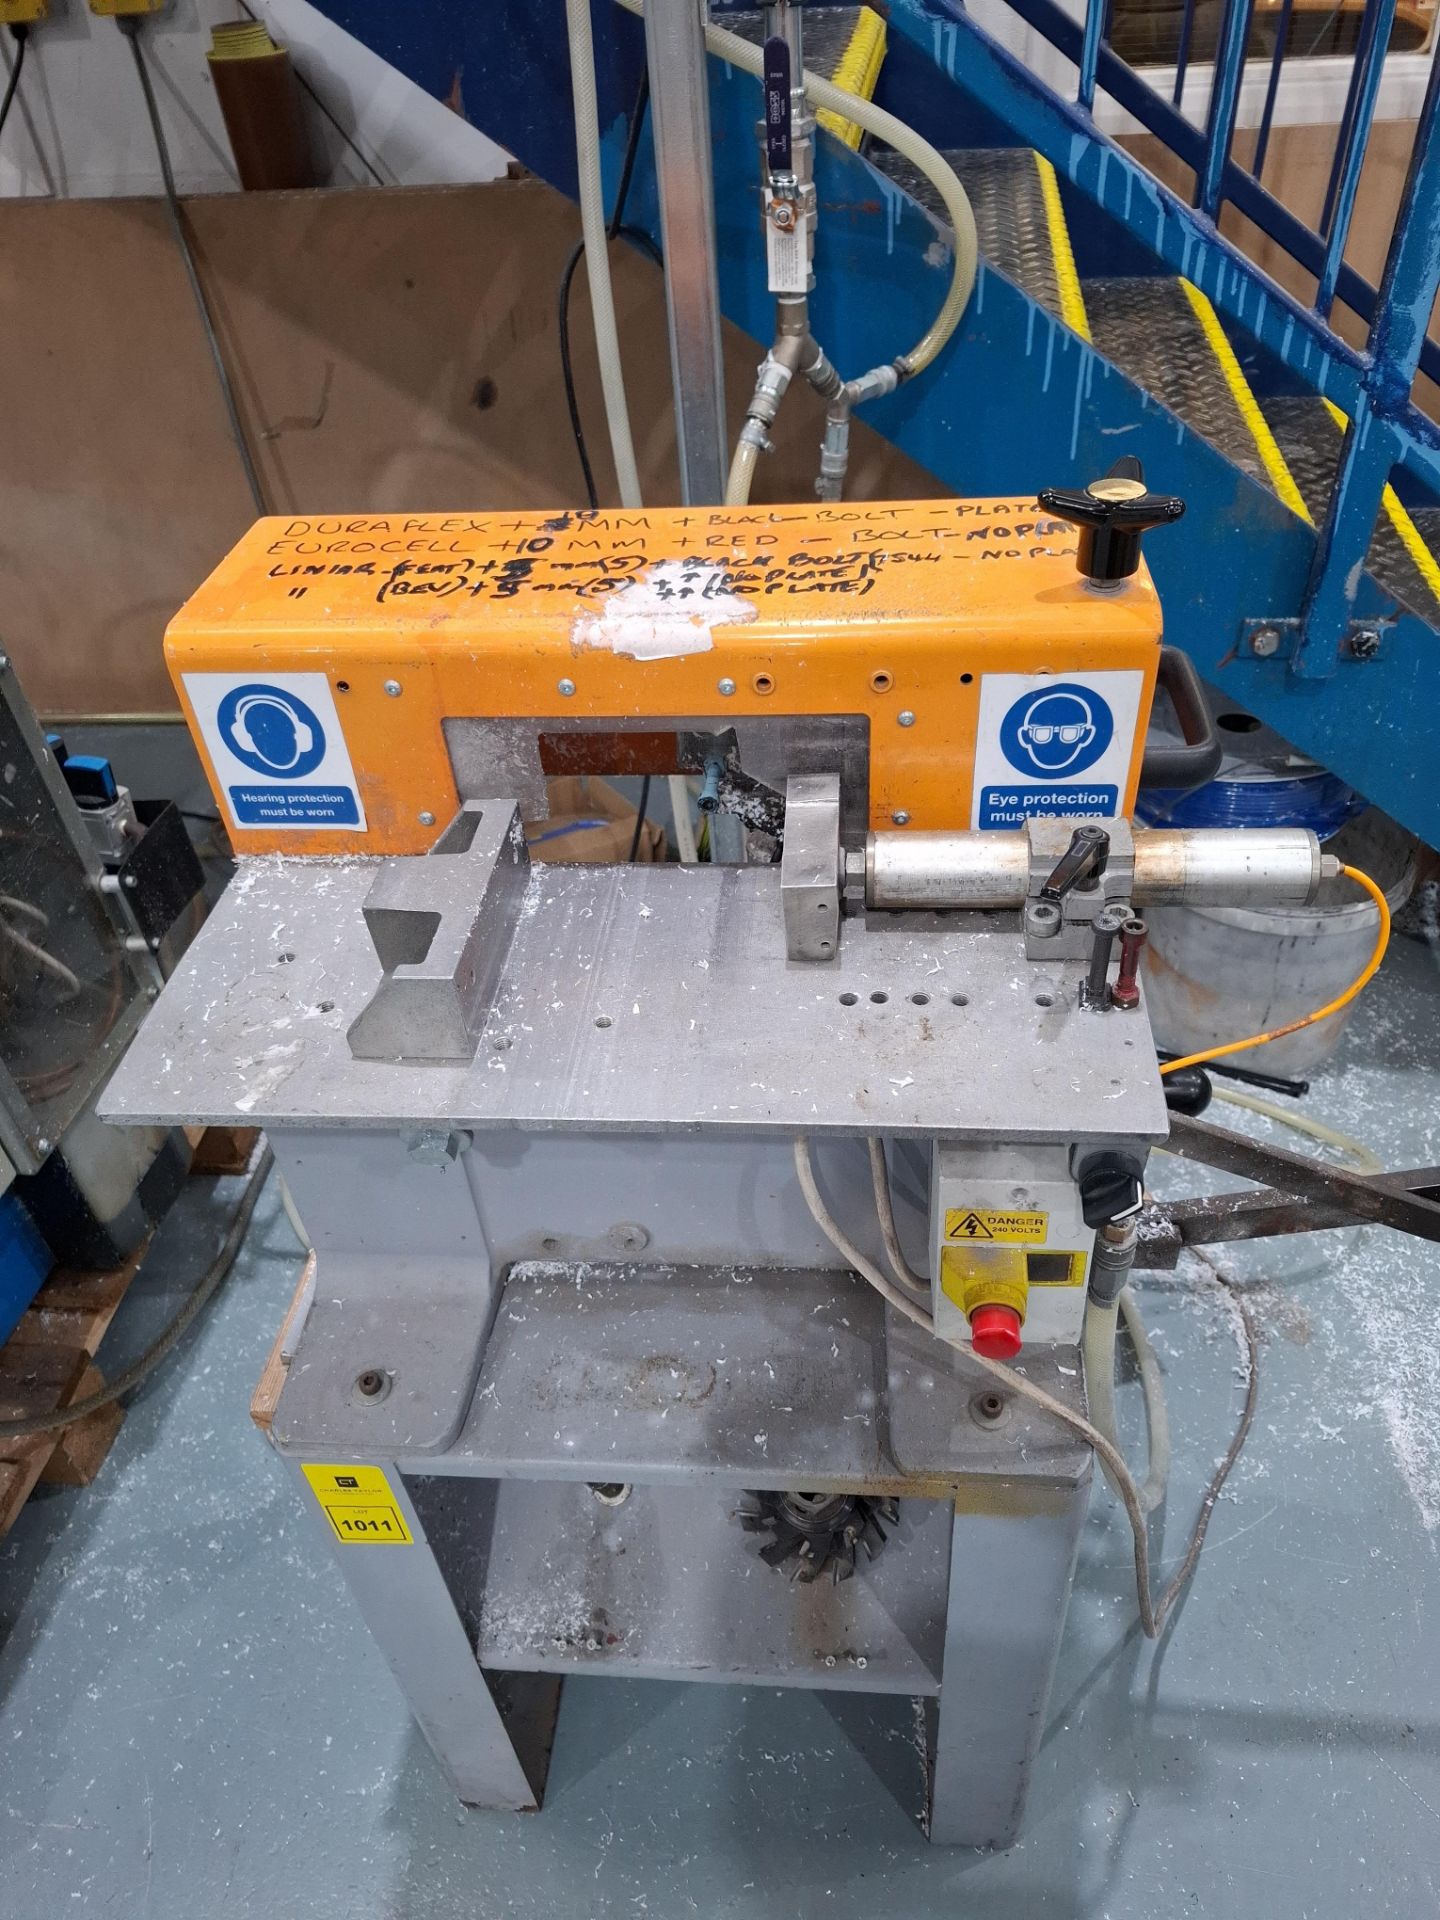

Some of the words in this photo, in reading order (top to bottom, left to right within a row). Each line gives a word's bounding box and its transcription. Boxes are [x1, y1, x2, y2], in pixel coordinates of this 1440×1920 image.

[816, 508, 914, 523] BOLT
[267, 540, 476, 555] EUROCELL
[706, 535, 779, 547] RED
[853, 528, 952, 542] BOLT
[241, 793, 285, 804] Hearing
[288, 793, 344, 804] protection
[988, 793, 1018, 807] Eye
[1023, 792, 1109, 807] protection
[260, 808, 288, 817] must
[290, 808, 304, 817] be
[306, 809, 335, 817] worn
[990, 810, 1031, 822] must
[987, 1217, 1044, 1226] DANGER
[341, 1519, 393, 1532] 1011
